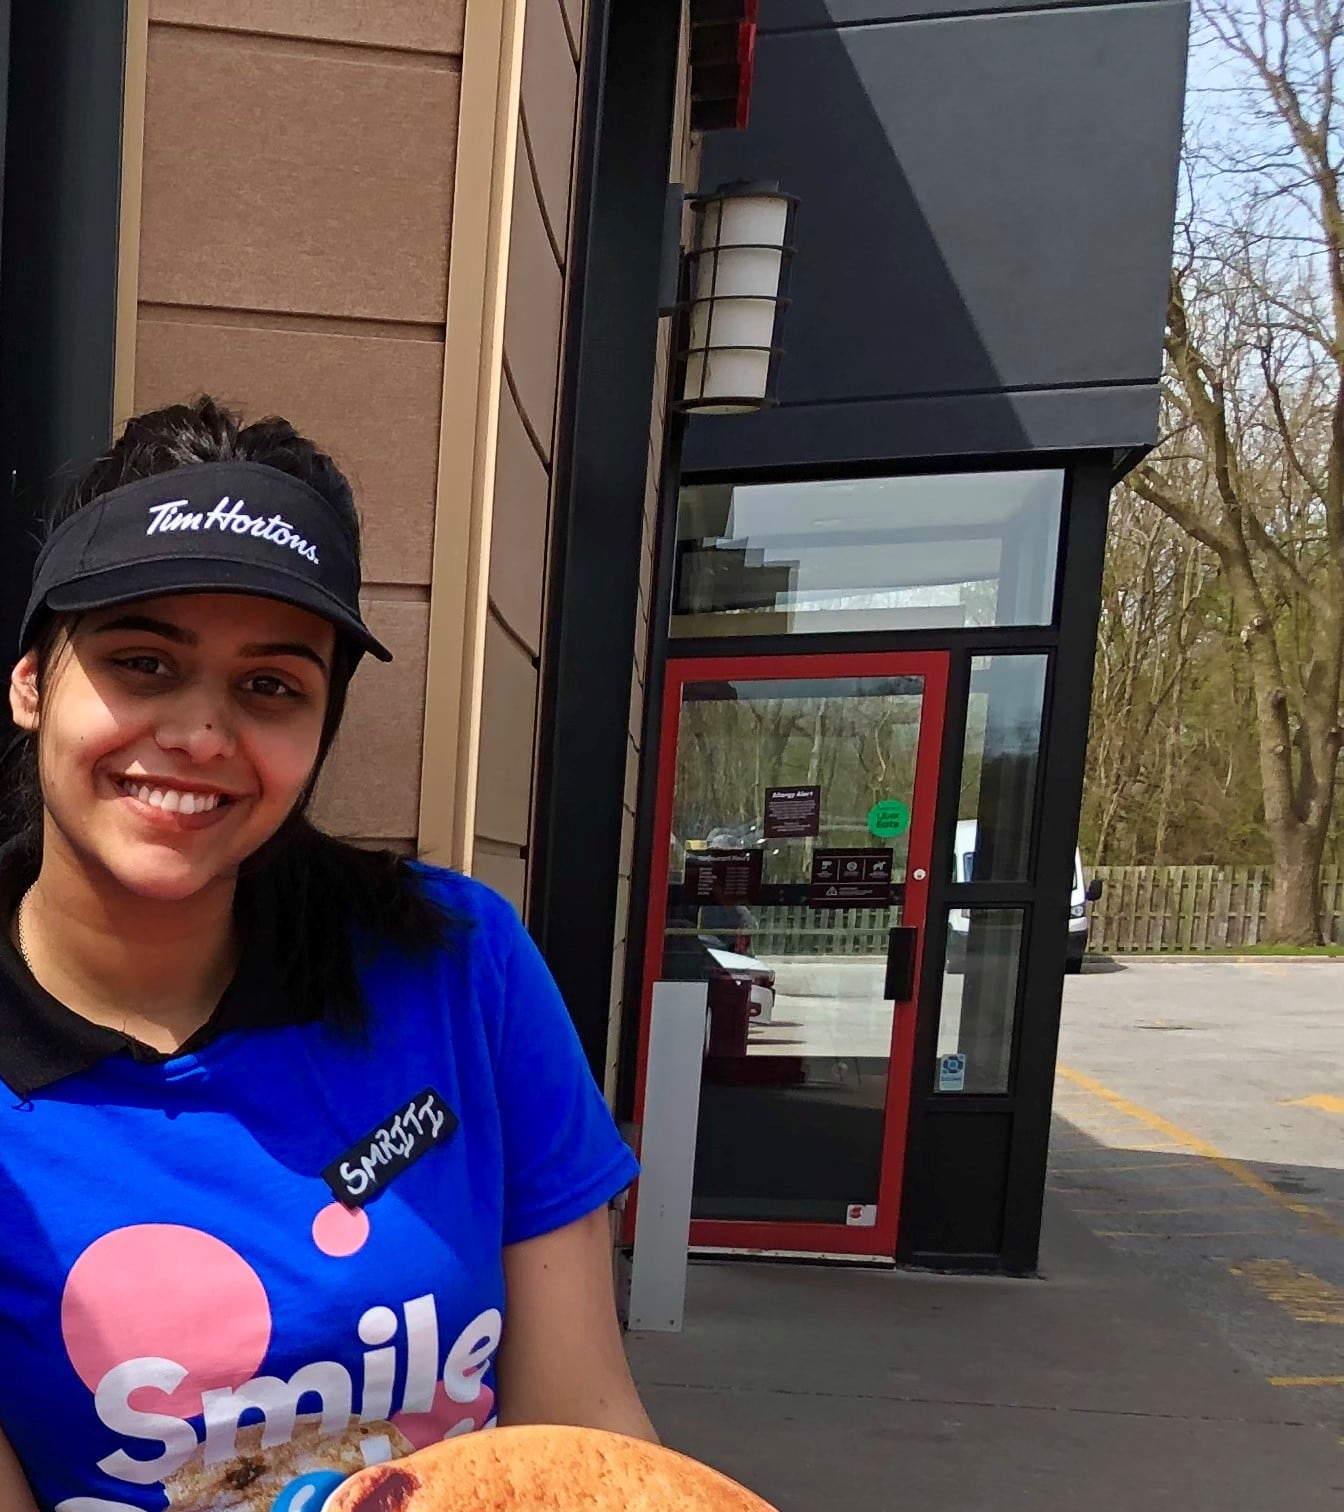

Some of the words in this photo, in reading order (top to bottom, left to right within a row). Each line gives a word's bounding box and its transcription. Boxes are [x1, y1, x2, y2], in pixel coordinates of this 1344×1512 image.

[146, 500, 200, 536] Tim
[339, 1095, 444, 1195] SMRITI
[94, 1293, 502, 1485] Smile
